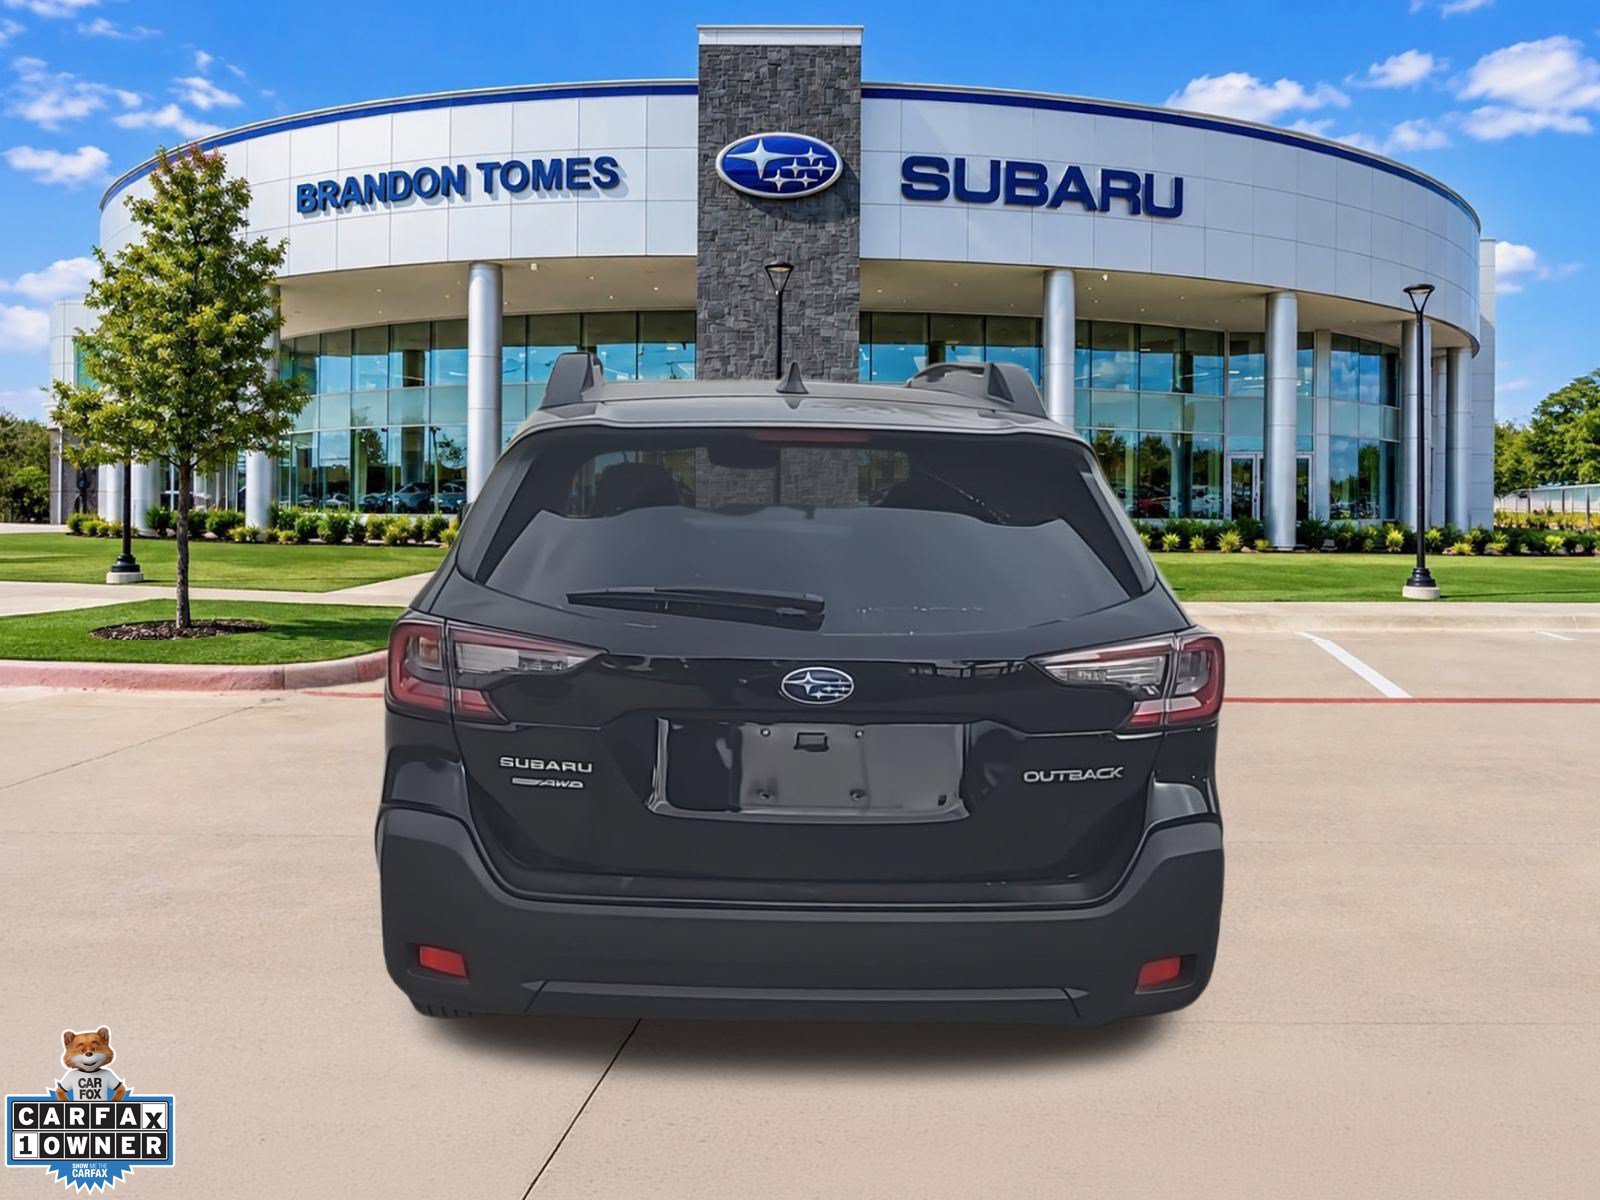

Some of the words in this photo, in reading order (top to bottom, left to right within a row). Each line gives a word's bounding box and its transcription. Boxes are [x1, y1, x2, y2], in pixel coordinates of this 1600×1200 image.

[295, 164, 467, 213] BRANDON
[476, 156, 621, 194] TOMES
[901, 155, 1184, 218] SUBARU
[500, 757, 592, 773] SUBARU
[1023, 766, 1124, 782] OUTBACK
